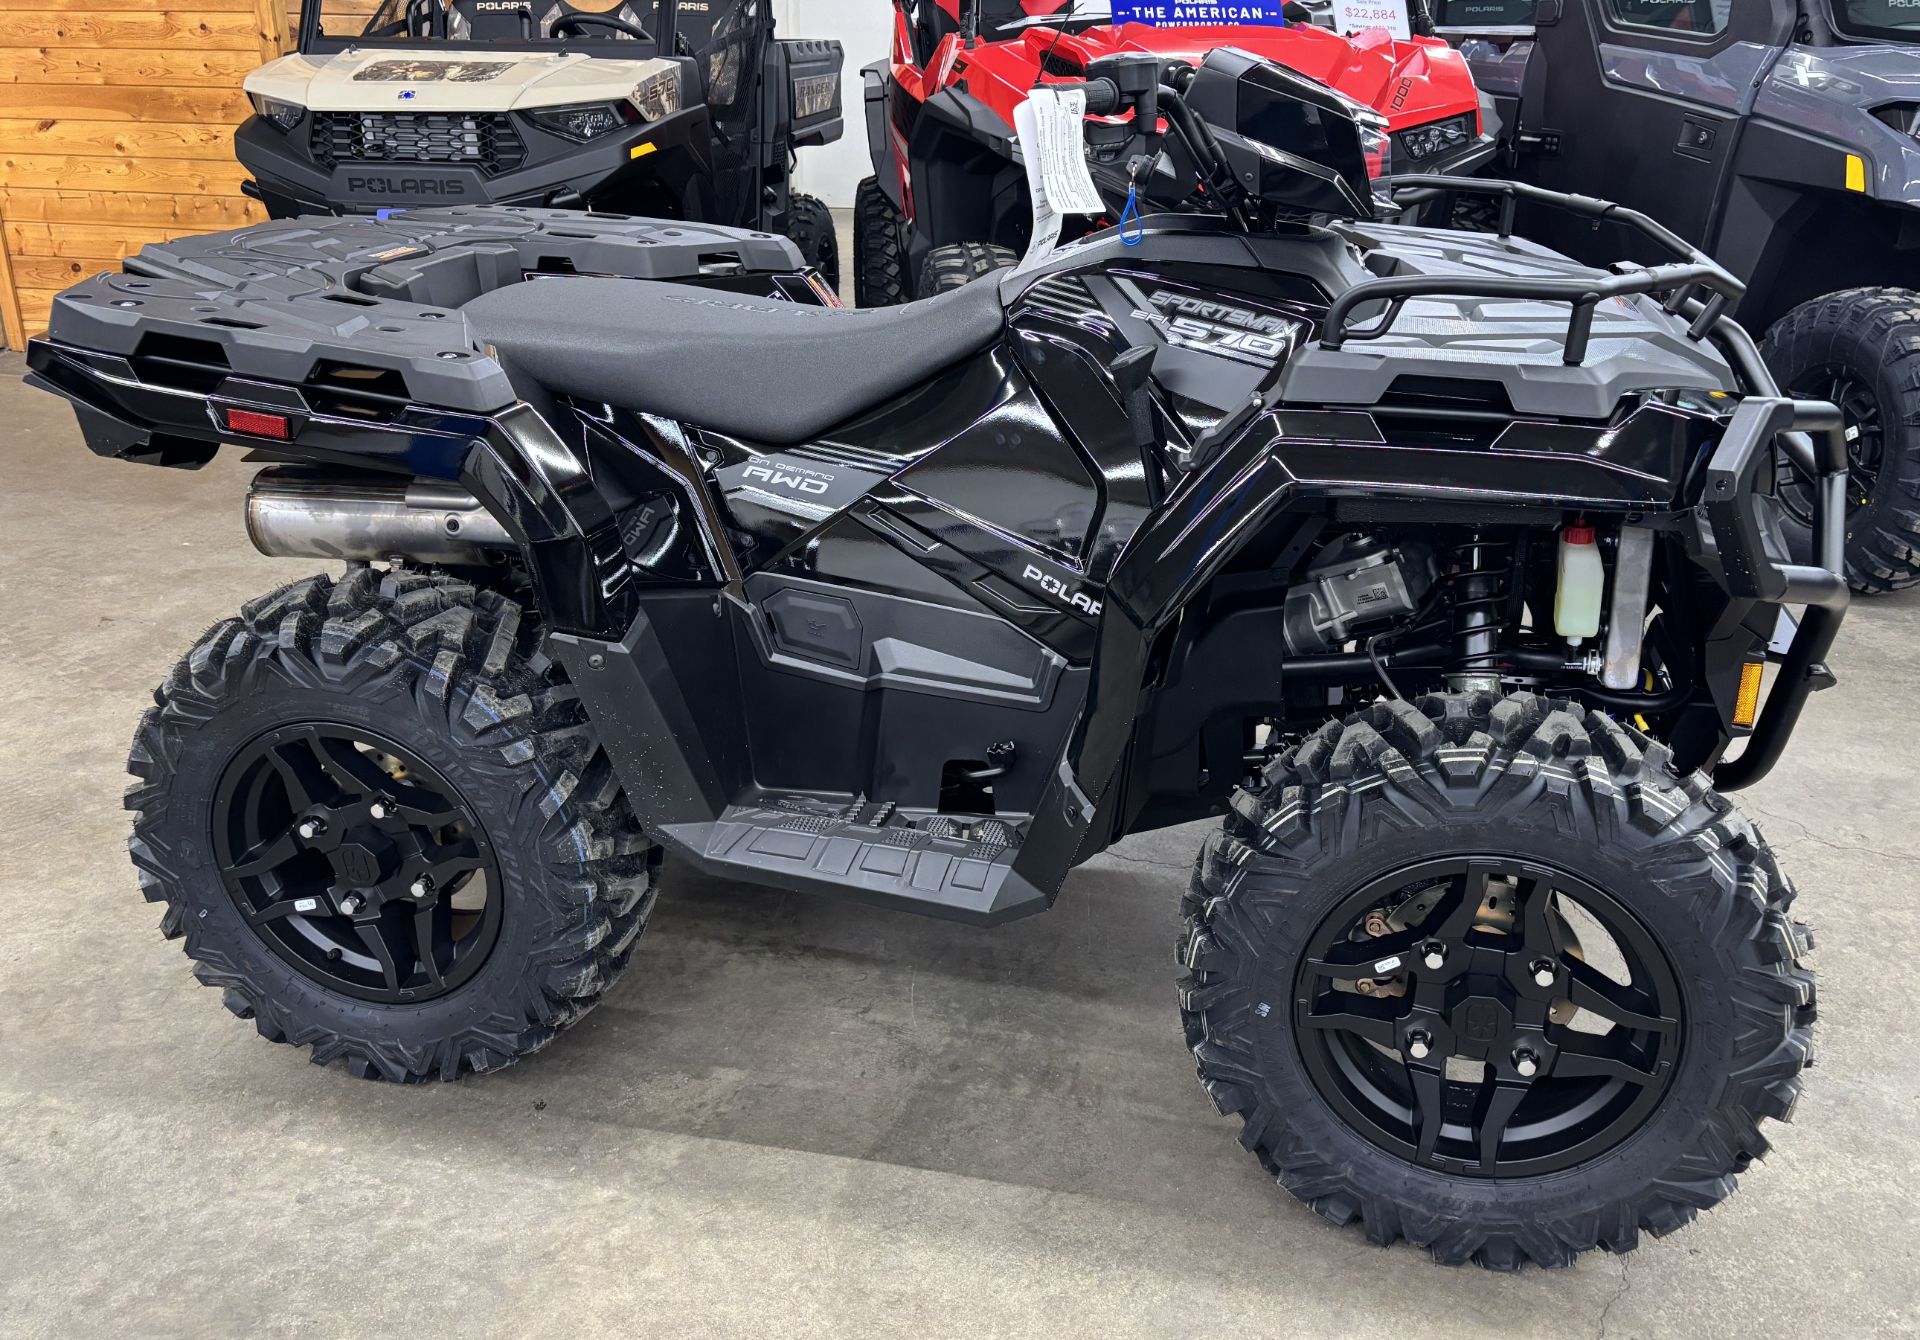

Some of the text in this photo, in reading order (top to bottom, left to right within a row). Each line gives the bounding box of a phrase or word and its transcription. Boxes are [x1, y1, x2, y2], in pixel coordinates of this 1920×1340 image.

[652, 1, 709, 11] PARIS
[1132, 7, 1263, 20] THE AMERICAN
[1344, 6, 1396, 20] $22,884
[649, 77, 674, 100] 570
[1390, 76, 1413, 111] 1000
[347, 177, 465, 195] POLARIS
[1148, 289, 1303, 337] SPORTSMAN
[1129, 308, 1286, 358] EFI 570
[742, 465, 829, 494] AWD
[775, 462, 835, 481] DEMAND
[1022, 563, 1103, 616] POLAR
